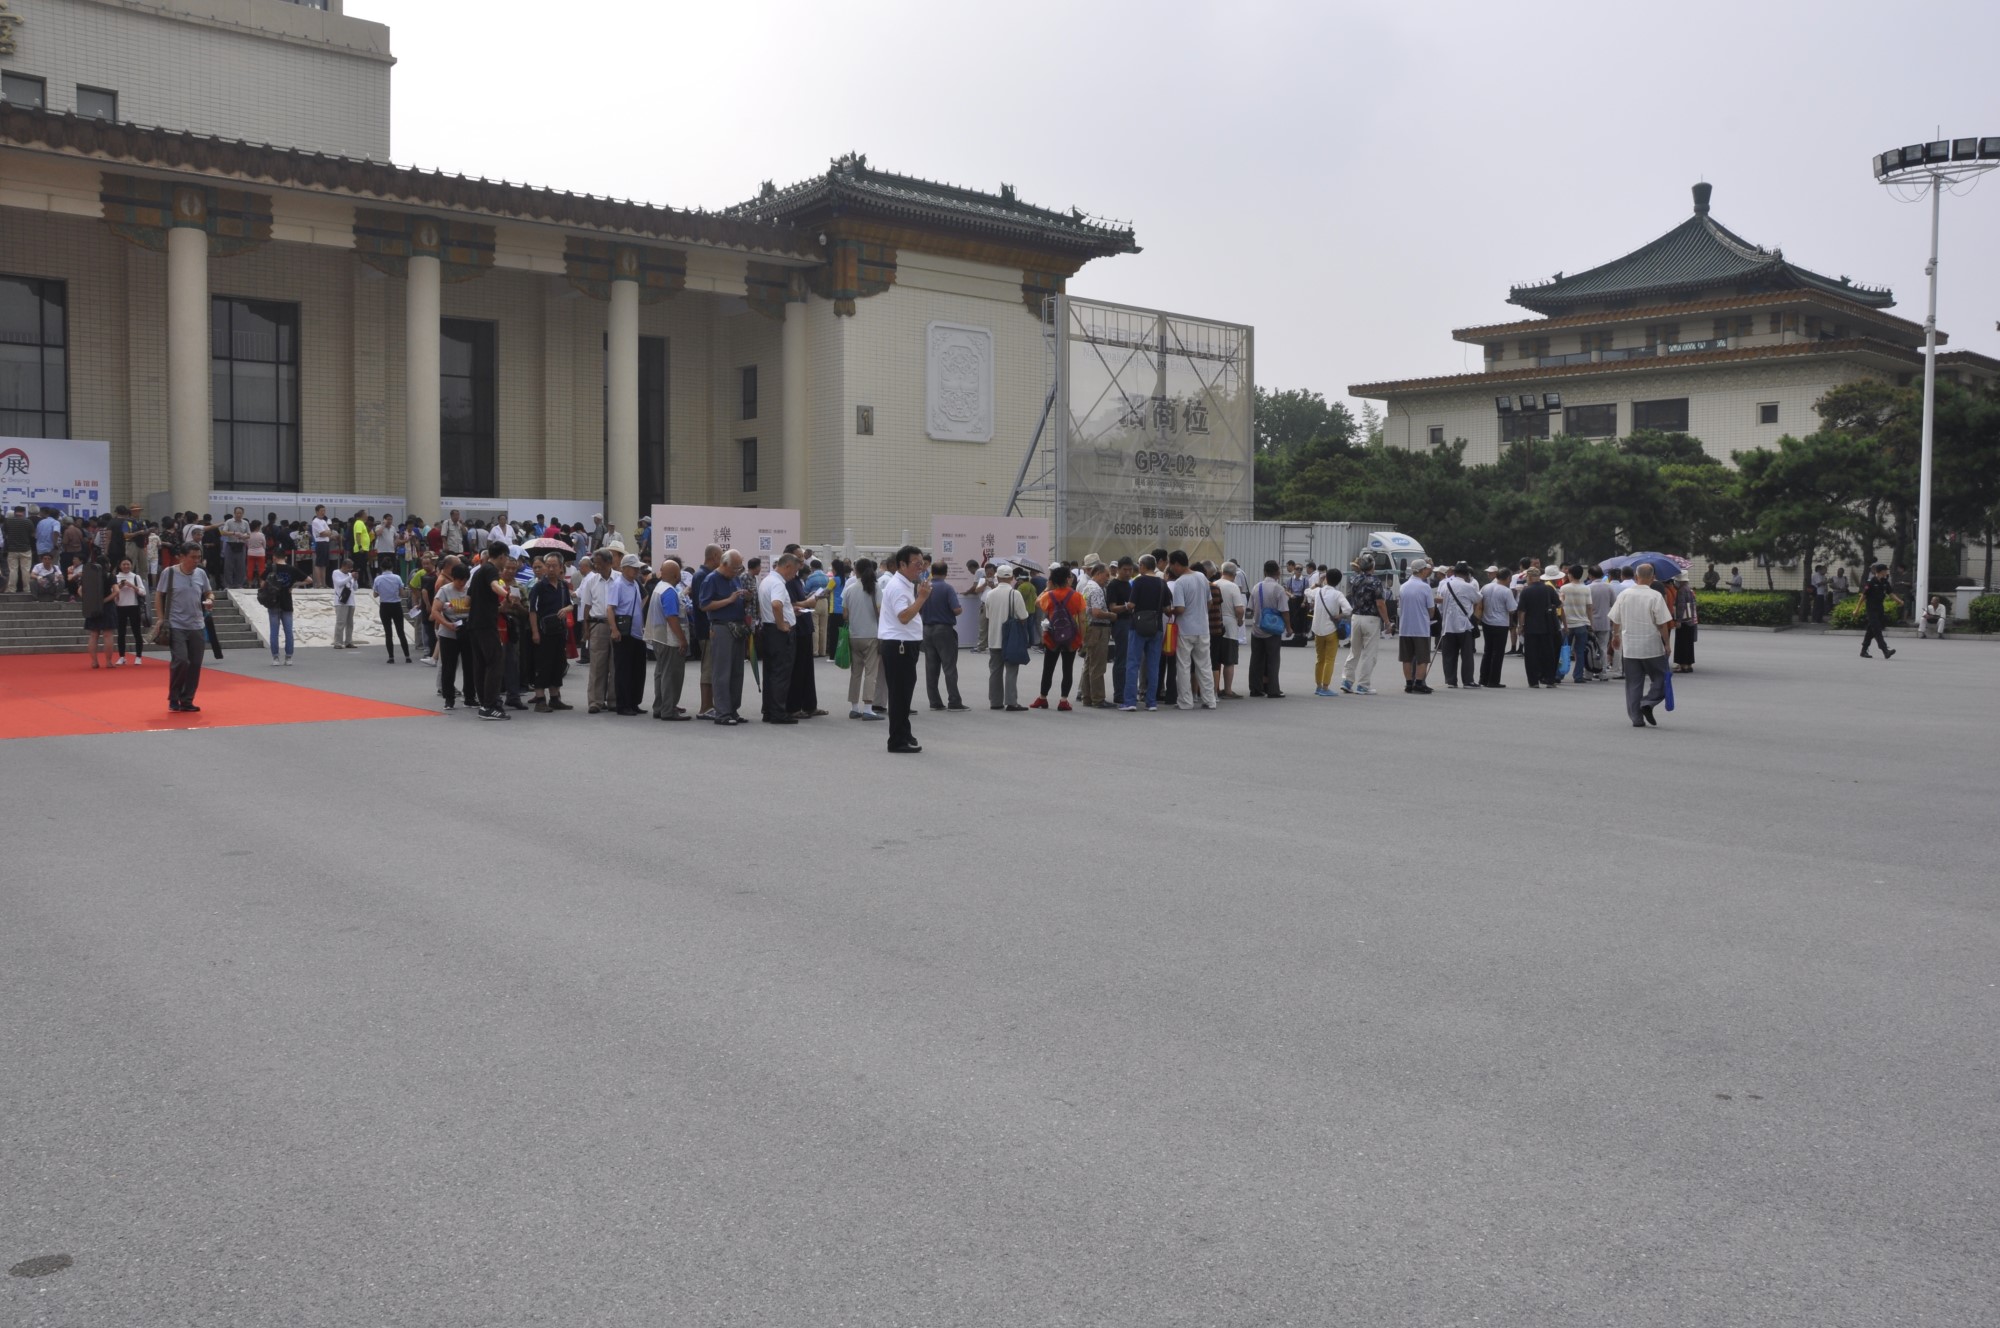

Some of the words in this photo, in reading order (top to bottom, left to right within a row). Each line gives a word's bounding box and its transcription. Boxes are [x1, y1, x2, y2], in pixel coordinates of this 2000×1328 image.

[0, 455, 29, 476] 展
[1135, 450, 1197, 477] GP2-02
[1114, 523, 1159, 536] 65096134
